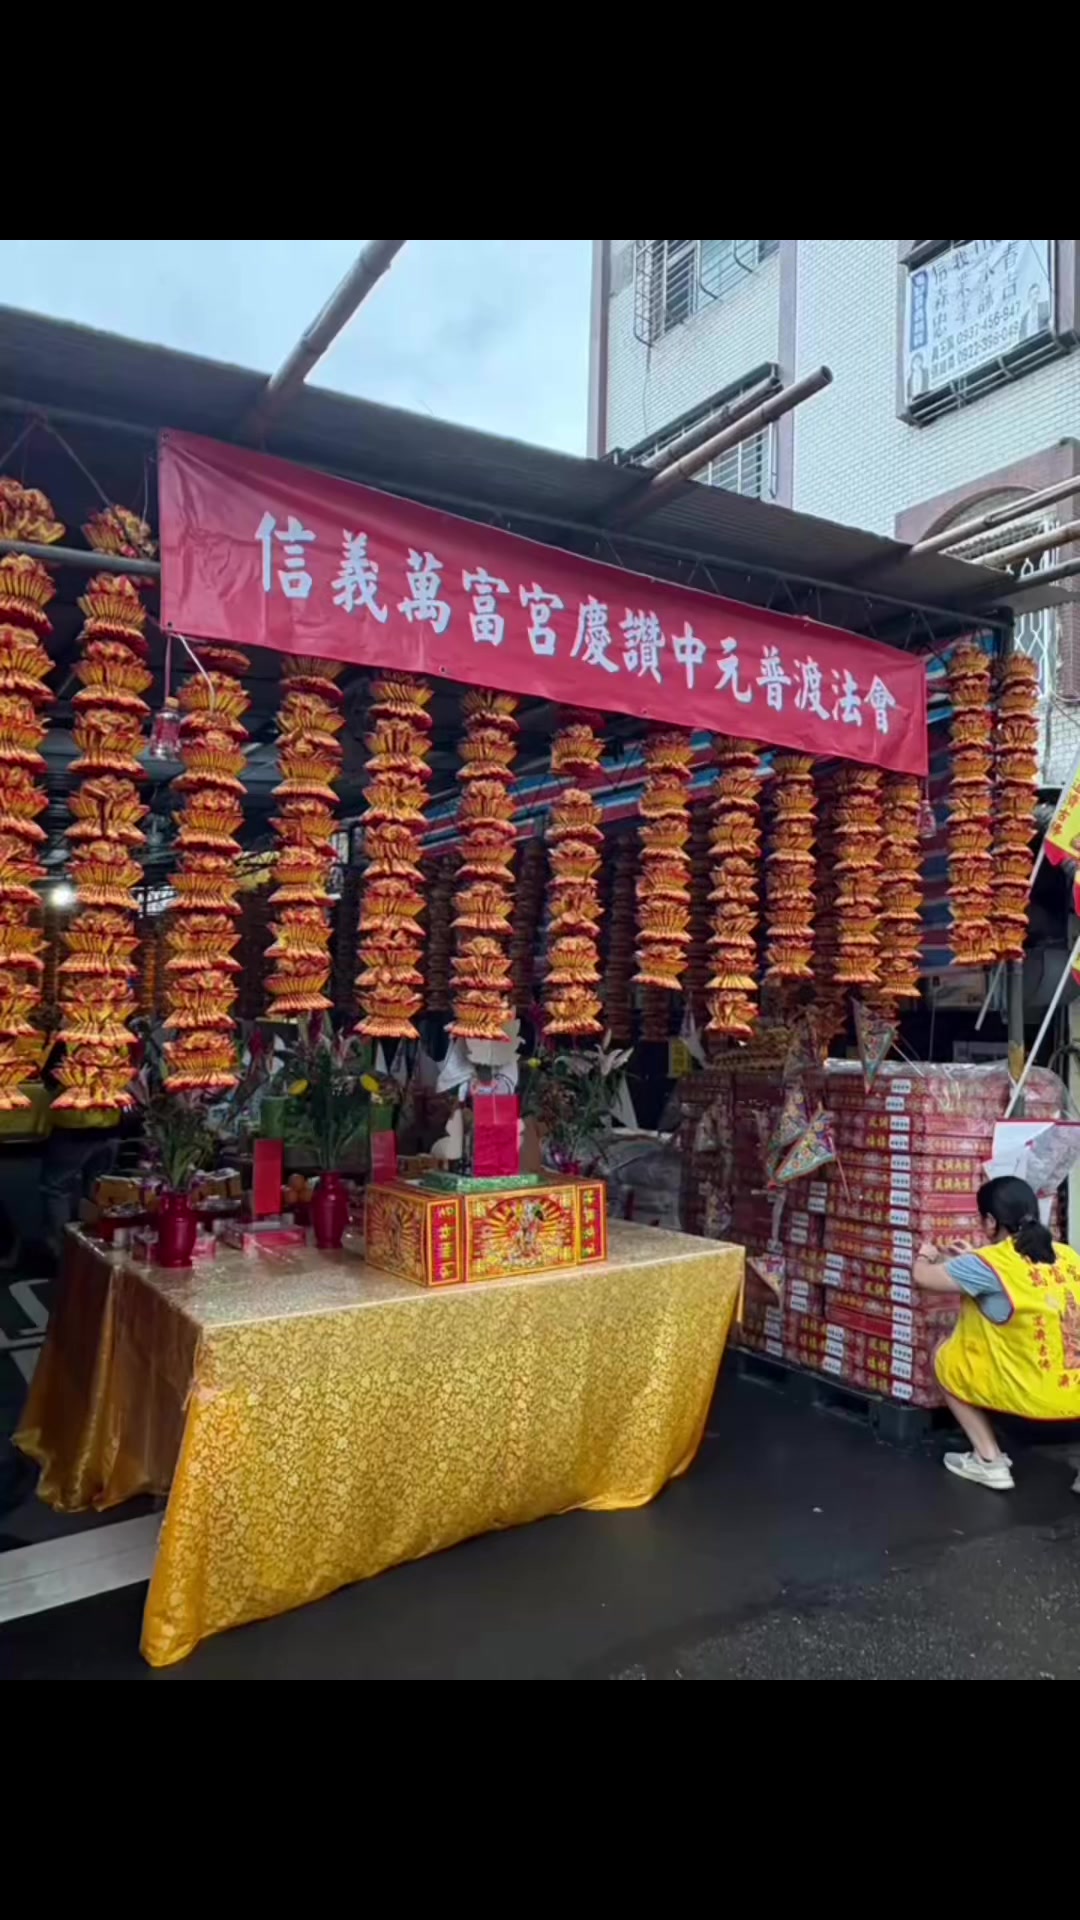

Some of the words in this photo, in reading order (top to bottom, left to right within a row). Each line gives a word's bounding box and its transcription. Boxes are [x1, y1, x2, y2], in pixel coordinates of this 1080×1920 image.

[255, 511, 897, 735] 信義萬富宮慶讚中元普渡法會
